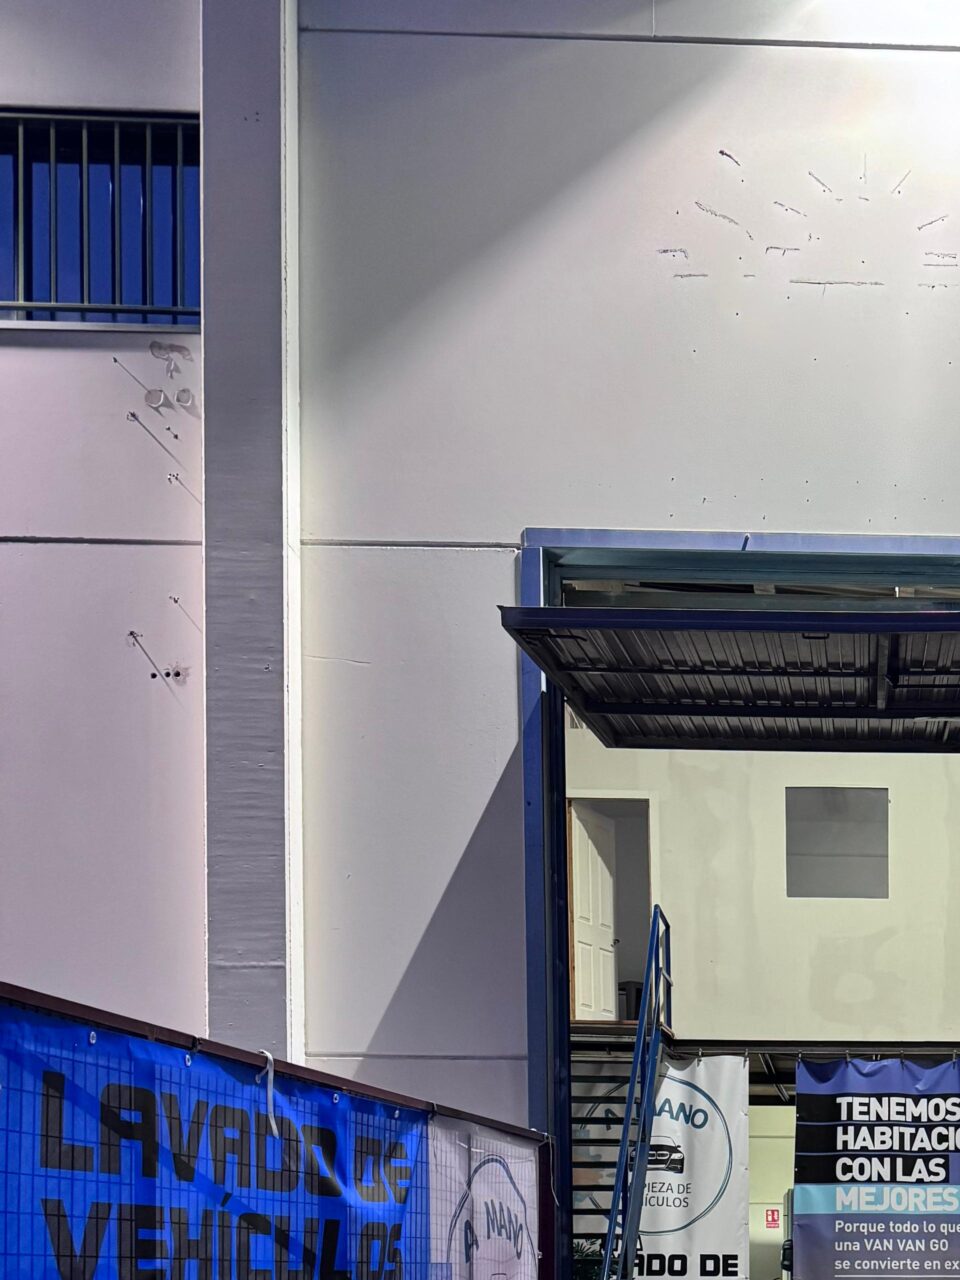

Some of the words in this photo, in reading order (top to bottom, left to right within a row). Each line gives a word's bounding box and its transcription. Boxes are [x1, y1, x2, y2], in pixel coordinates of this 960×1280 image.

[653, 1098, 708, 1129] ANO
[40, 1070, 346, 1197] LAVADO
[354, 1135, 412, 1205] DE
[835, 1157, 890, 1182] CON
[896, 1157, 947, 1182] LAS
[677, 1183, 692, 1194] DE
[836, 1186, 960, 1212] MEJORES
[643, 1193, 689, 1208] ÍCULOS
[464, 1219, 479, 1264] A
[484, 1199, 523, 1260] MANO
[835, 1220, 885, 1235] Porque
[889, 1221, 919, 1233] todo
[923, 1221, 936, 1233] lo
[834, 1241, 860, 1251] una
[864, 1239, 893, 1251] VAN
[897, 1239, 926, 1251] VAN
[929, 1239, 949, 1251] GO
[699, 1254, 739, 1277] DE
[834, 1259, 850, 1270] se
[854, 1257, 920, 1270] convierte
[924, 1260, 941, 1270] en
